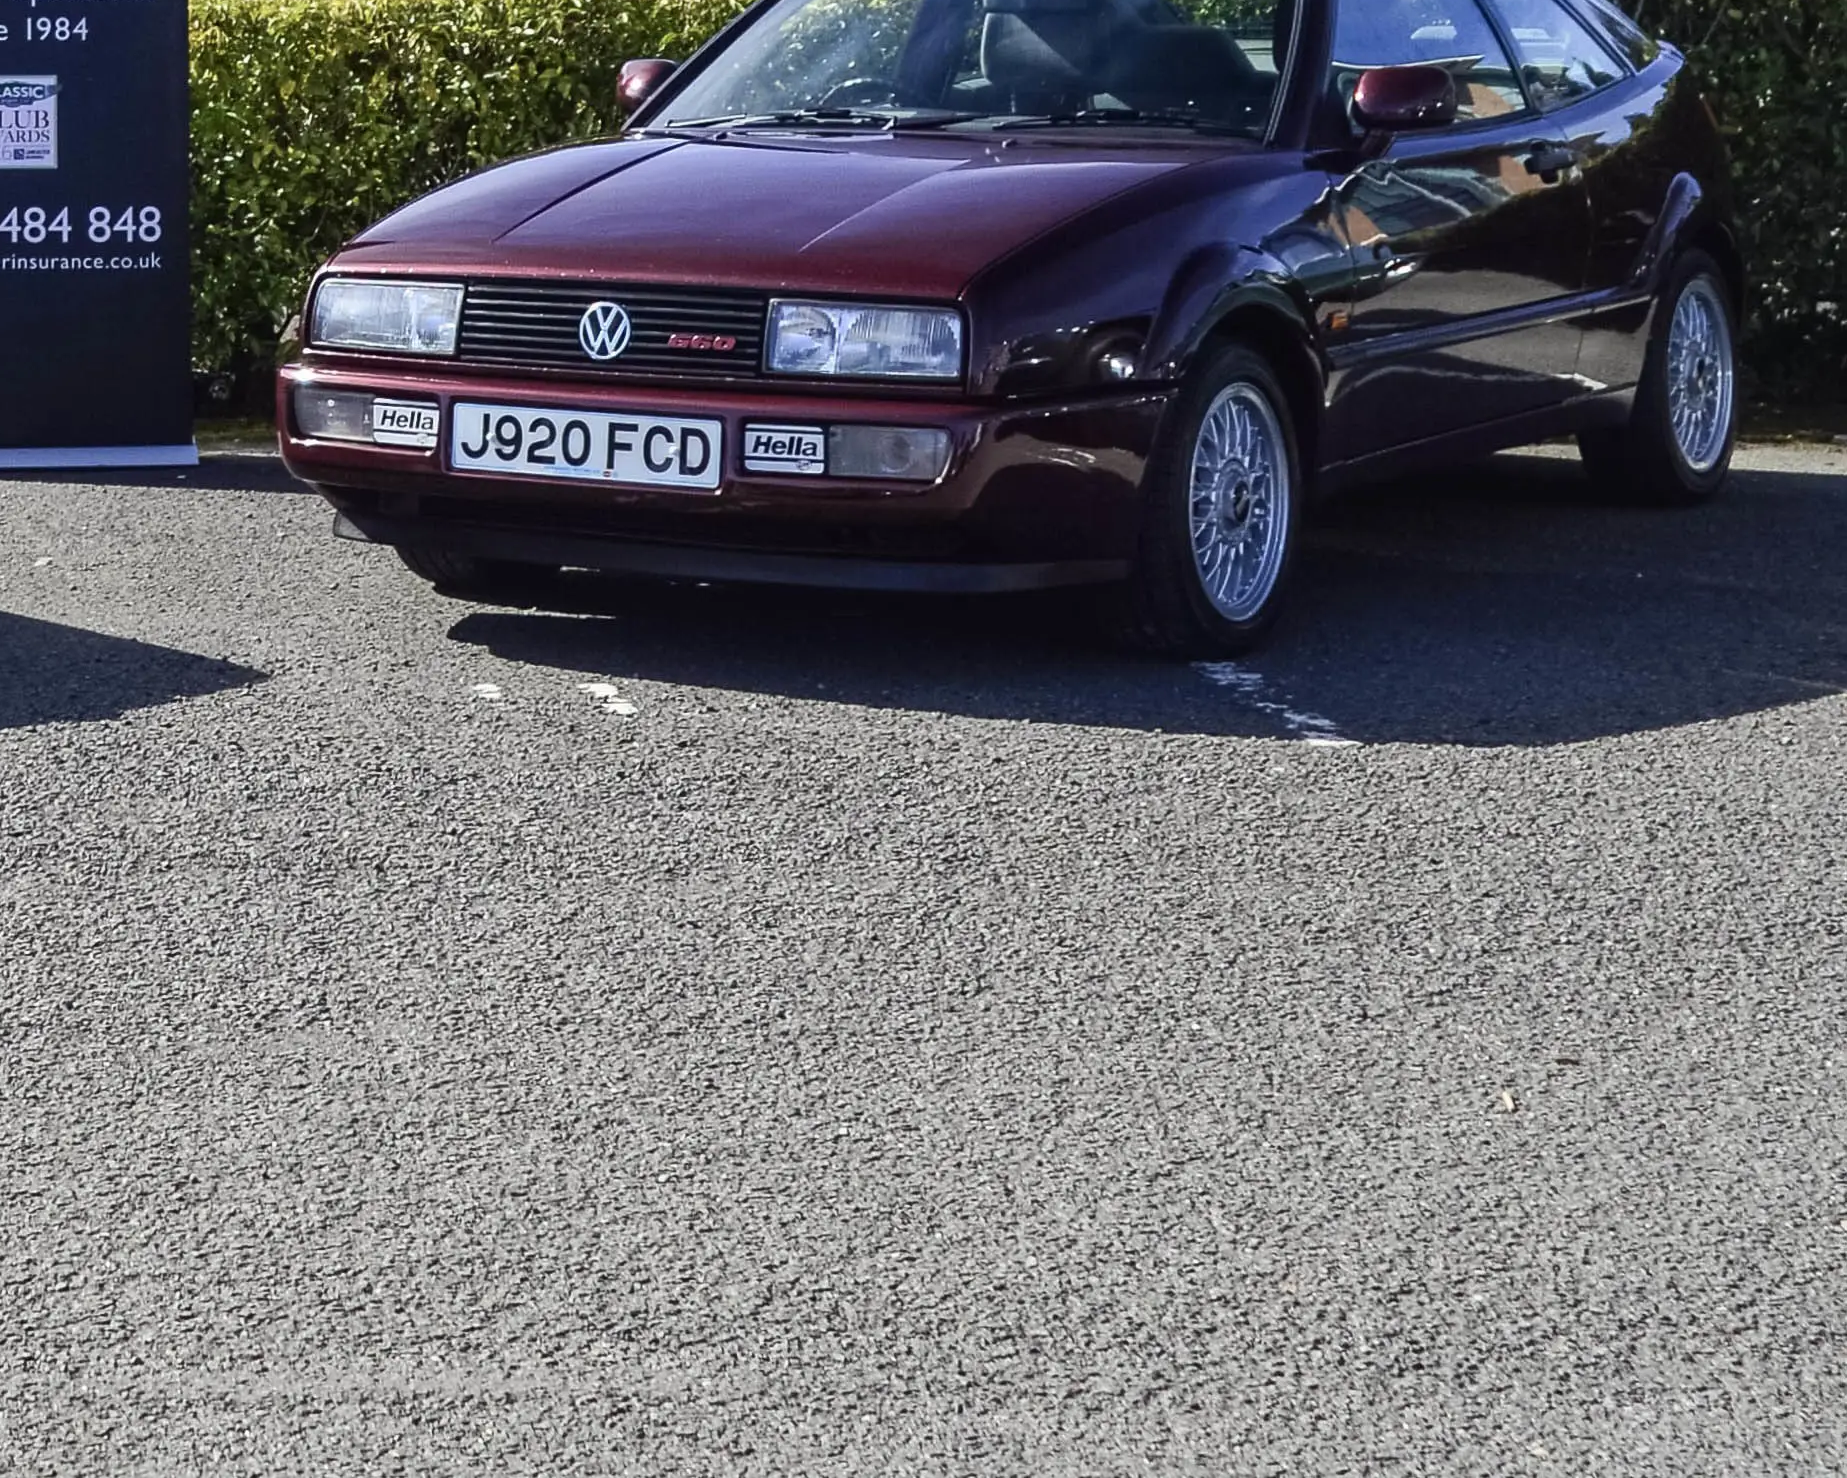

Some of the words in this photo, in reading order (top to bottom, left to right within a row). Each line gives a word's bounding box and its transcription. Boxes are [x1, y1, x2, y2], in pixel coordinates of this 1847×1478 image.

[26, 16, 89, 41] 1984
[88, 205, 162, 243] 848
[380, 409, 434, 431] Hella
[460, 412, 592, 468] J920
[606, 422, 711, 476] FCD
[752, 435, 818, 457] Hella
